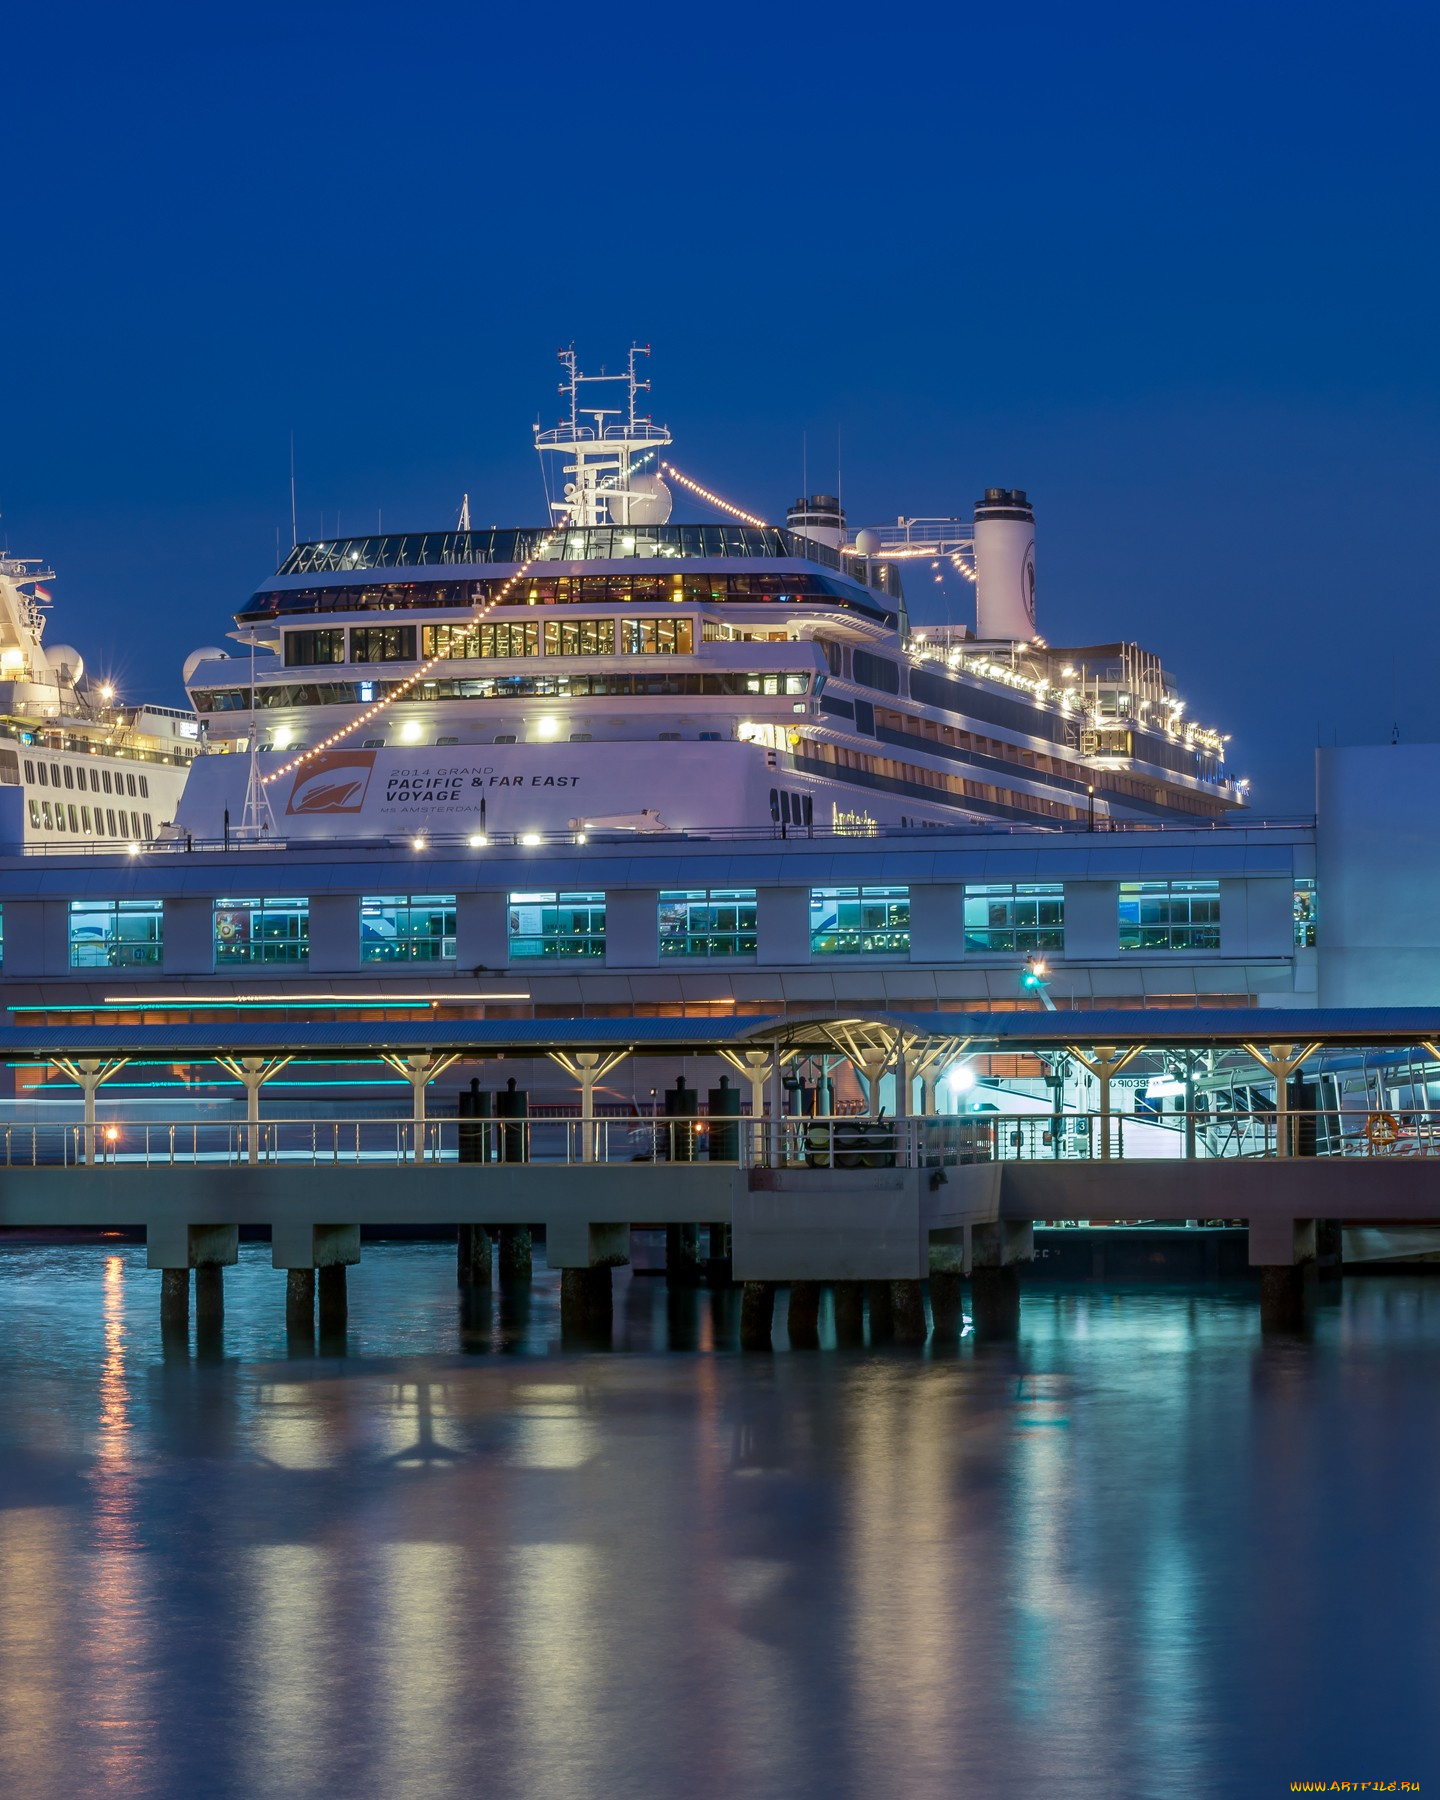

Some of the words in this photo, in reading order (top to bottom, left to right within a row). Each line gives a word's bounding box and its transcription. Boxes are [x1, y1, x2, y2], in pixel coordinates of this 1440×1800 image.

[390, 768, 430, 777] 2014
[437, 767, 494, 776] GRAND
[387, 777, 464, 789] PACIFIC
[471, 777, 483, 787] &
[489, 776, 525, 787] FAR
[531, 776, 581, 787] EAST
[386, 790, 461, 802] VOYAGE
[1079, 1120, 1086, 1131] 3
